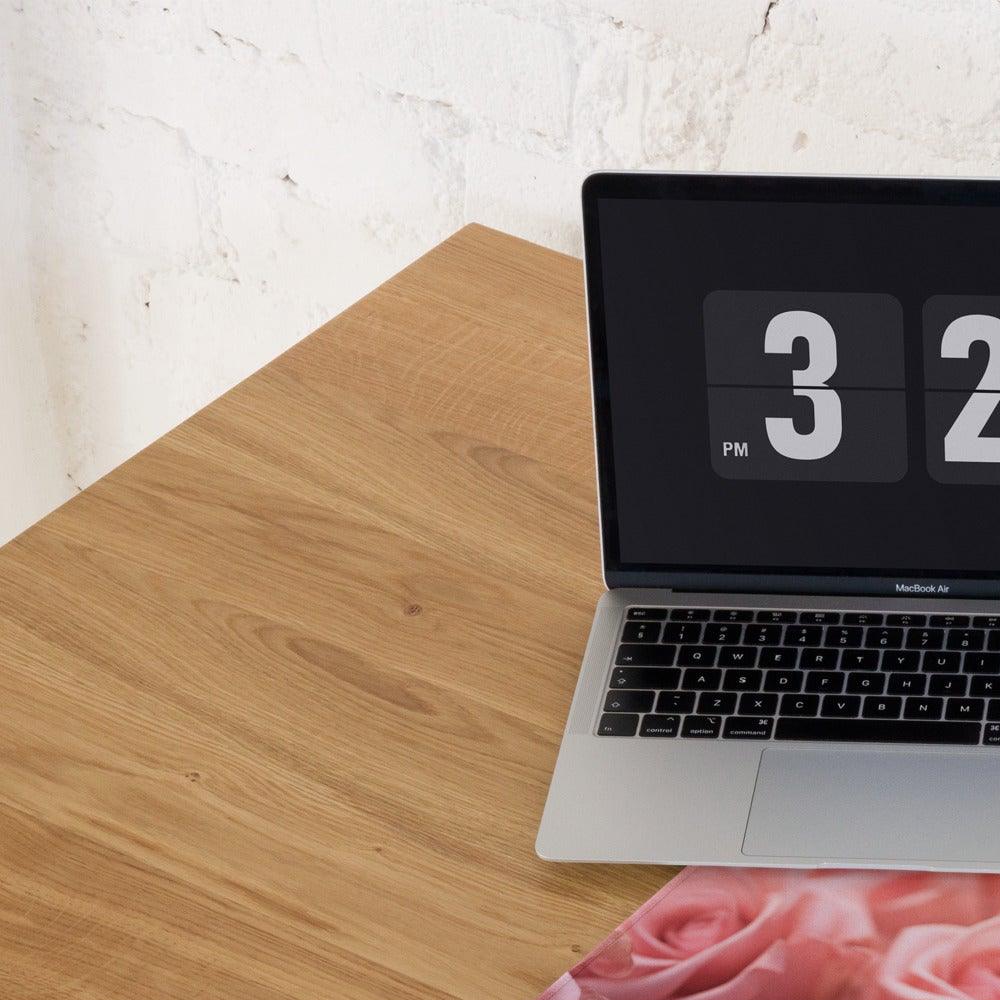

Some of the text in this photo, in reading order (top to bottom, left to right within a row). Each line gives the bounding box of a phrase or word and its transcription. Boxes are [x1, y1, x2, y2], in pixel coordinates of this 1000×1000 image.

[764, 310, 843, 461] 3
[723, 441, 749, 457] PM
[895, 583, 950, 593] MacBook Air
[718, 633, 726, 641] 2
[921, 638, 928, 646] 7
[961, 639, 969, 647] 8
[692, 652, 702, 660] Q
[774, 654, 782, 662] E
[937, 658, 946, 666] U
[738, 676, 747, 684] S
[779, 677, 788, 685] D
[821, 678, 829, 686] F
[861, 679, 870, 687] G
[944, 681, 952, 689] J
[985, 682, 993, 690] K
[713, 699, 722, 707] Z
[754, 700, 762, 708] X
[795, 701, 804, 709] C
[837, 702, 846, 710] V
[878, 703, 886, 711] B
[919, 704, 928, 712] N
